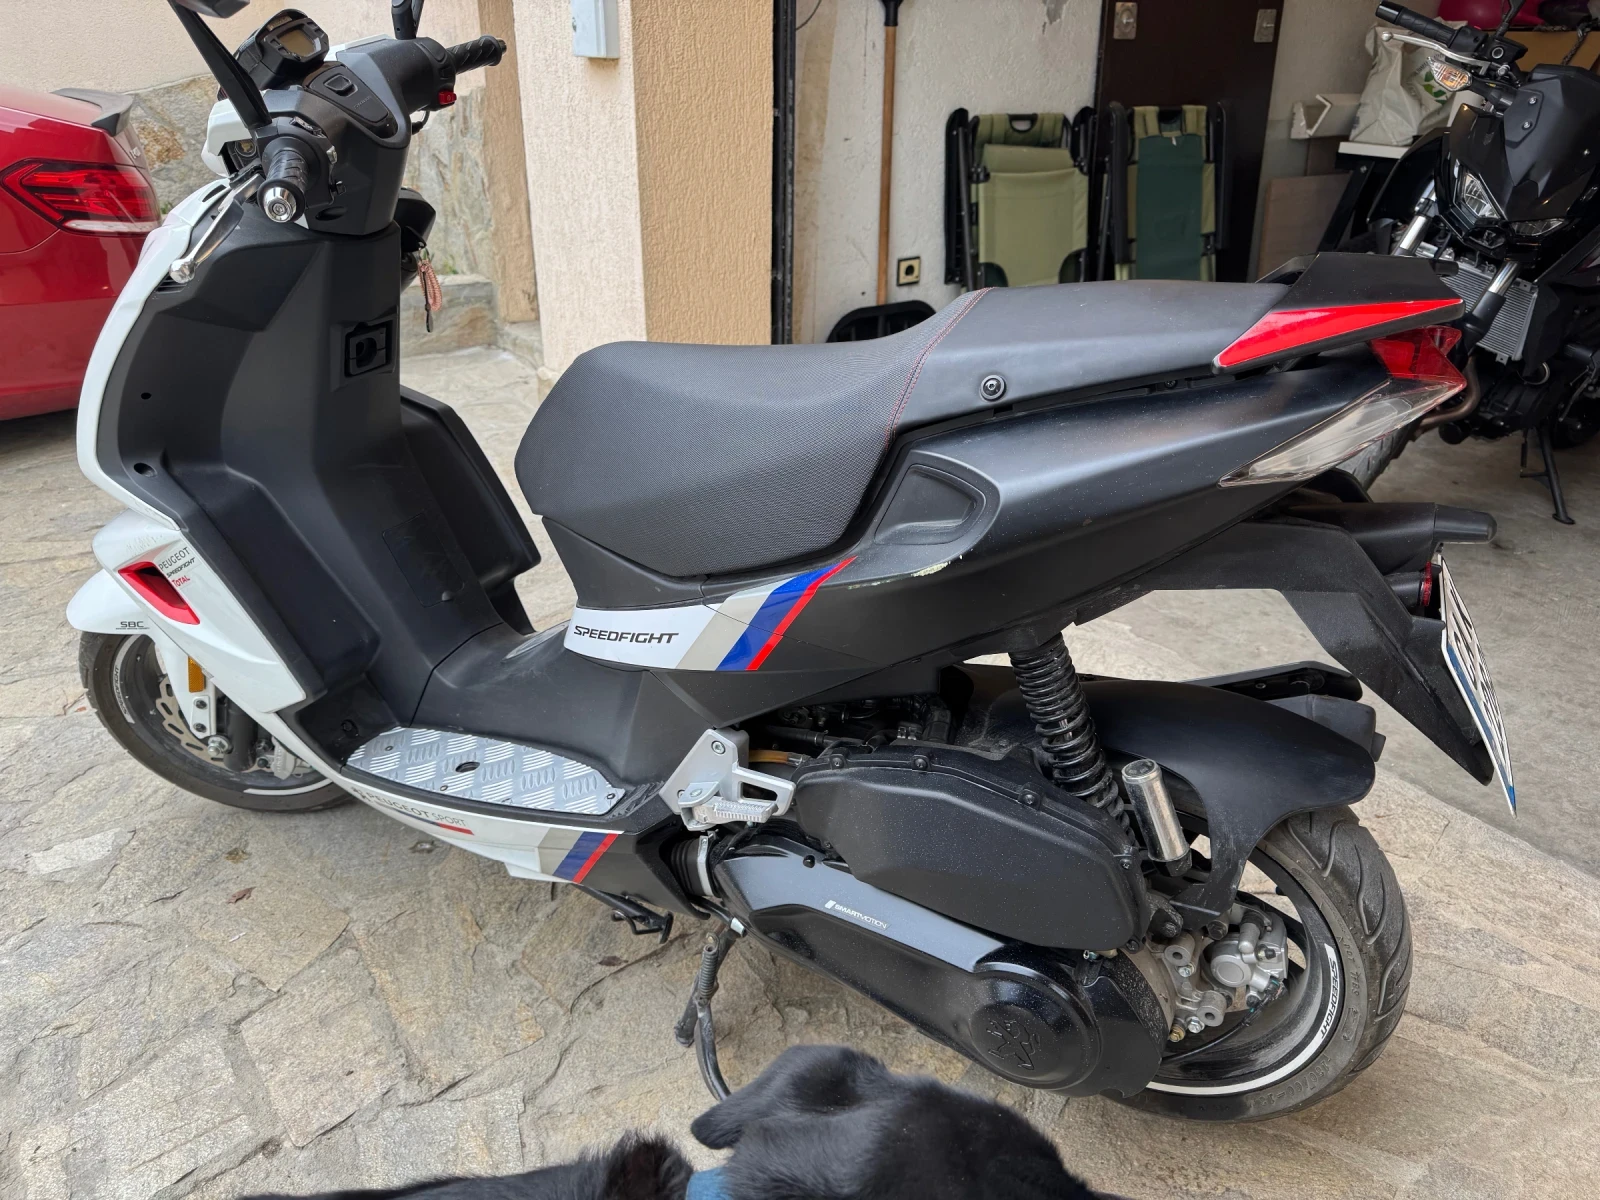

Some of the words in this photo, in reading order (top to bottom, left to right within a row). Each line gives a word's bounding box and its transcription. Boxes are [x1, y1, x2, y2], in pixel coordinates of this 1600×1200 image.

[158, 546, 190, 571] PEUGEOT
[120, 620, 144, 628] SBC
[573, 625, 680, 644] SPEEDFIGHT
[366, 793, 430, 817] PEUGEOT
[431, 813, 467, 827] SPORT
[834, 904, 887, 929] SMARTMOTION
[1320, 957, 1340, 1039] SPEEDFIGHT
